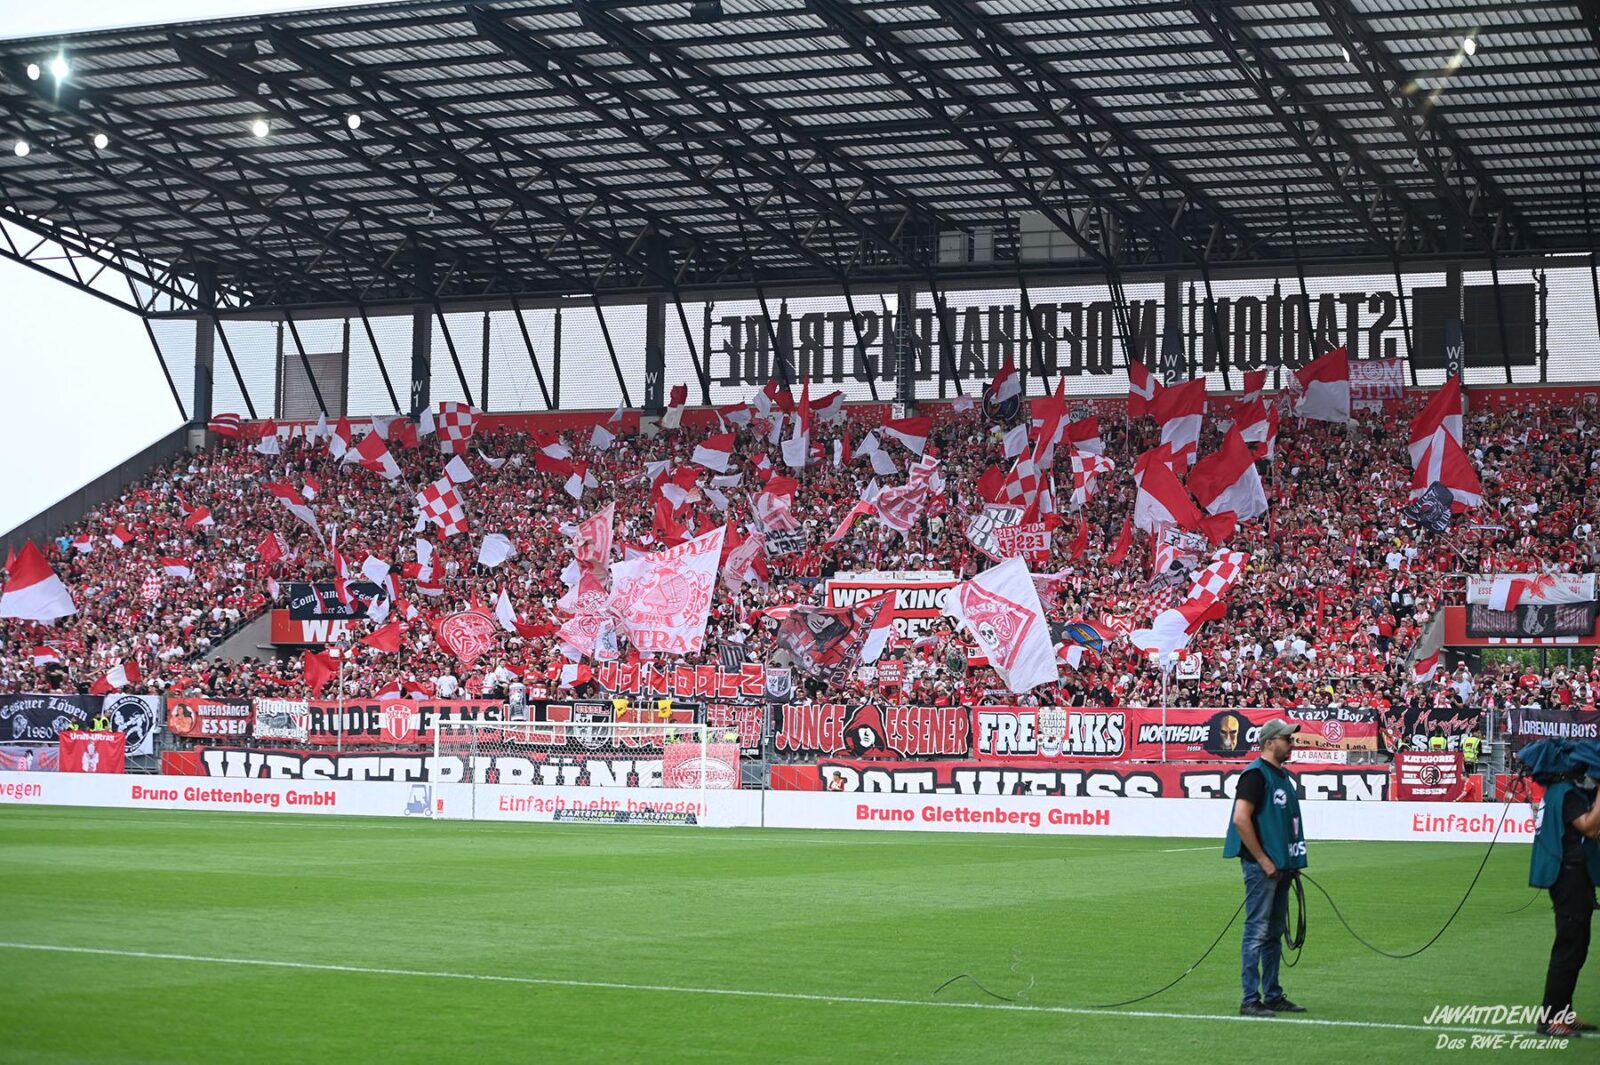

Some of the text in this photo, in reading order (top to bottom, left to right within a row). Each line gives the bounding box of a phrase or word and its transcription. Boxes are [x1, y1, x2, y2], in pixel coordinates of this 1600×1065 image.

[1446, 346, 1460, 360] W
[1164, 354, 1178, 385] W 2
[411, 380, 423, 408] W 1
[645, 372, 657, 401] W 1
[599, 661, 764, 698] VANDALZ
[1, 697, 88, 721] Essener Löwen
[707, 704, 763, 720] SEKTION
[27, 726, 53, 739] 1980
[201, 719, 247, 735] ESSEN
[311, 706, 381, 736] RUDE
[418, 706, 504, 736] FANS
[776, 704, 969, 755] JUNGE ESSENER
[1518, 715, 1597, 738] ADRENALIN BOYS
[978, 712, 1126, 757] FREAKS
[1138, 724, 1211, 744] NORTHSIDE
[1297, 751, 1307, 759] LA
[1309, 751, 1332, 760] BANDA
[131, 785, 336, 808] Bruno Glettenberg GmbH
[1184, 773, 1387, 801] EEN
[499, 795, 566, 813] Einfach
[856, 804, 1110, 827] Bruno Glettenberg GmbH
[1412, 812, 1494, 833] Einfach
